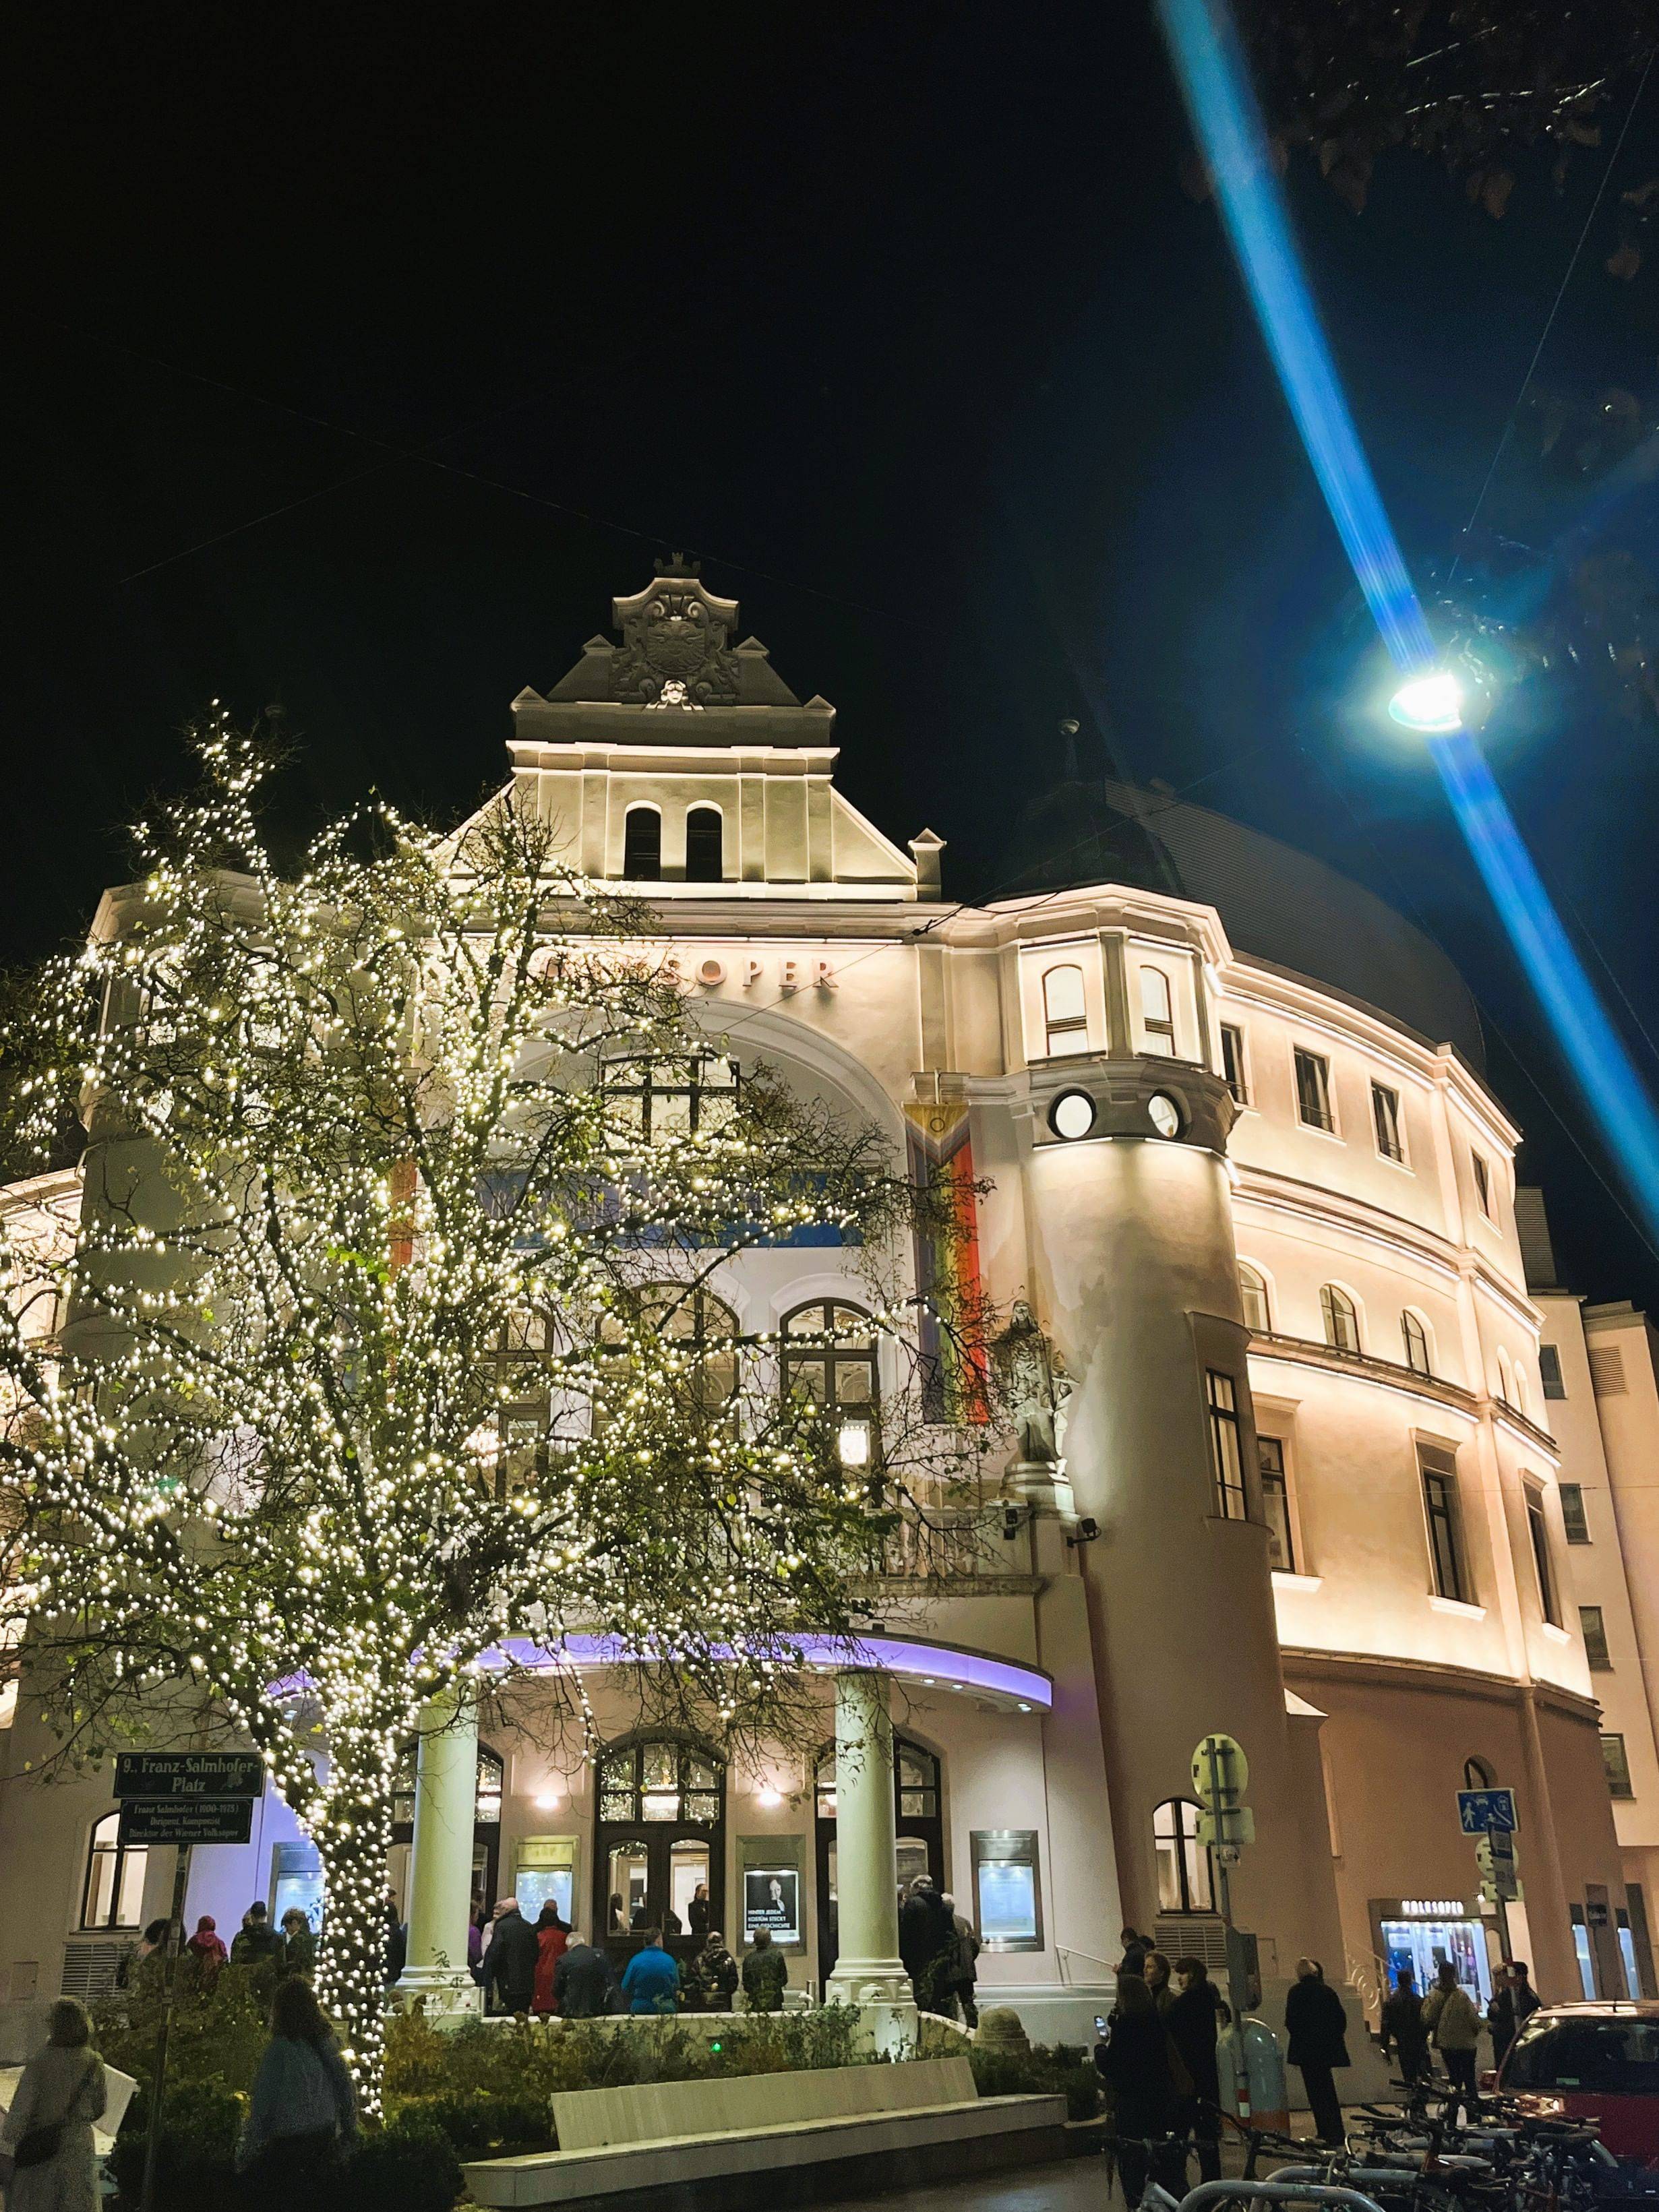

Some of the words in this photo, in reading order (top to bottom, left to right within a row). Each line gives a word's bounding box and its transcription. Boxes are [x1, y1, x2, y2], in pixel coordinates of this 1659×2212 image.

[141, 1756, 259, 1773] Franz-Salmhofer-
[171, 1777, 206, 1793] Platz
[134, 1804, 155, 1814] Franz
[157, 1804, 193, 1814] Salmhofer
[160, 1828, 173, 1838] der
[175, 1828, 202, 1838] Wiener
